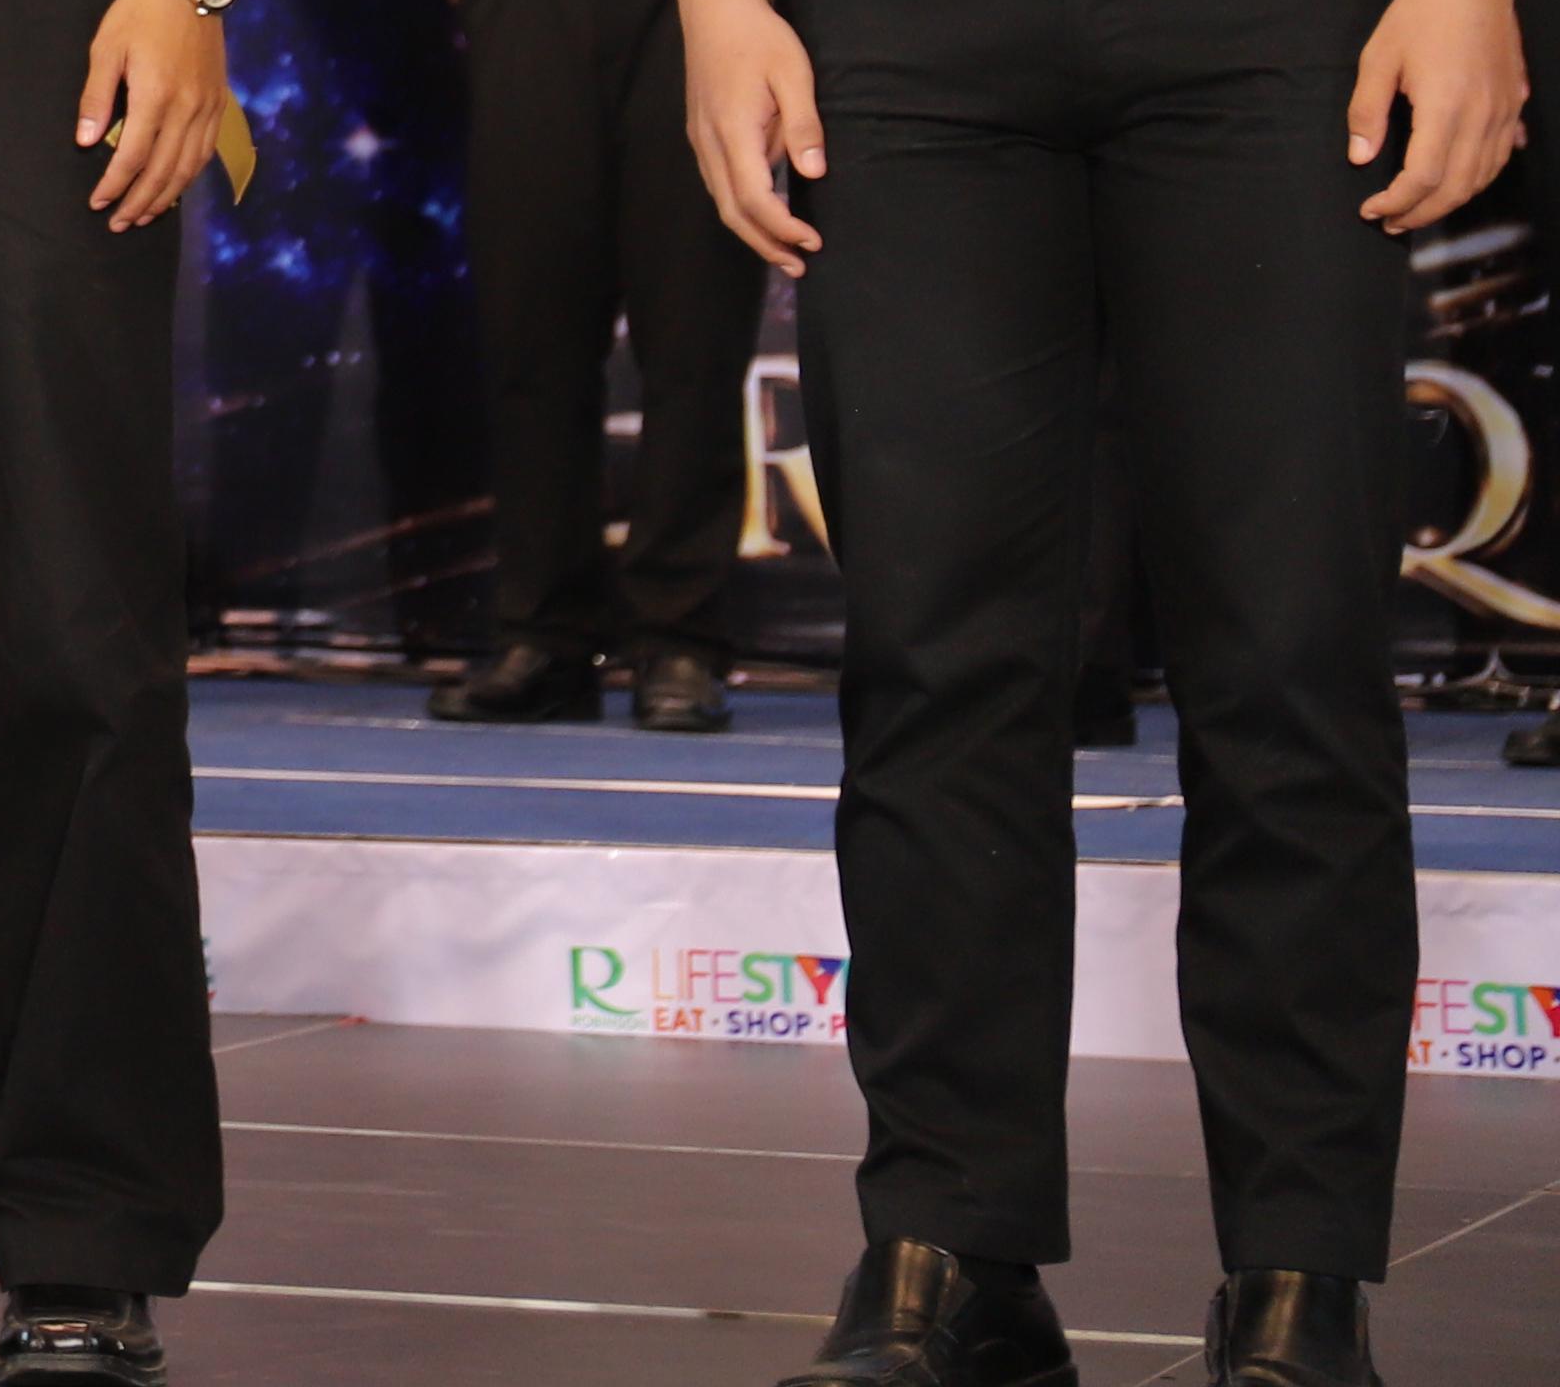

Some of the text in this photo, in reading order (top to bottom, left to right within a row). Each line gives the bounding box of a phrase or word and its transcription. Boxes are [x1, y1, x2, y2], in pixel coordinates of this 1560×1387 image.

[651, 946, 849, 1006] LIFESTY
[653, 1008, 707, 1032] EAT
[726, 1010, 813, 1037] SHOP
[1456, 1042, 1547, 1070] SHOP
